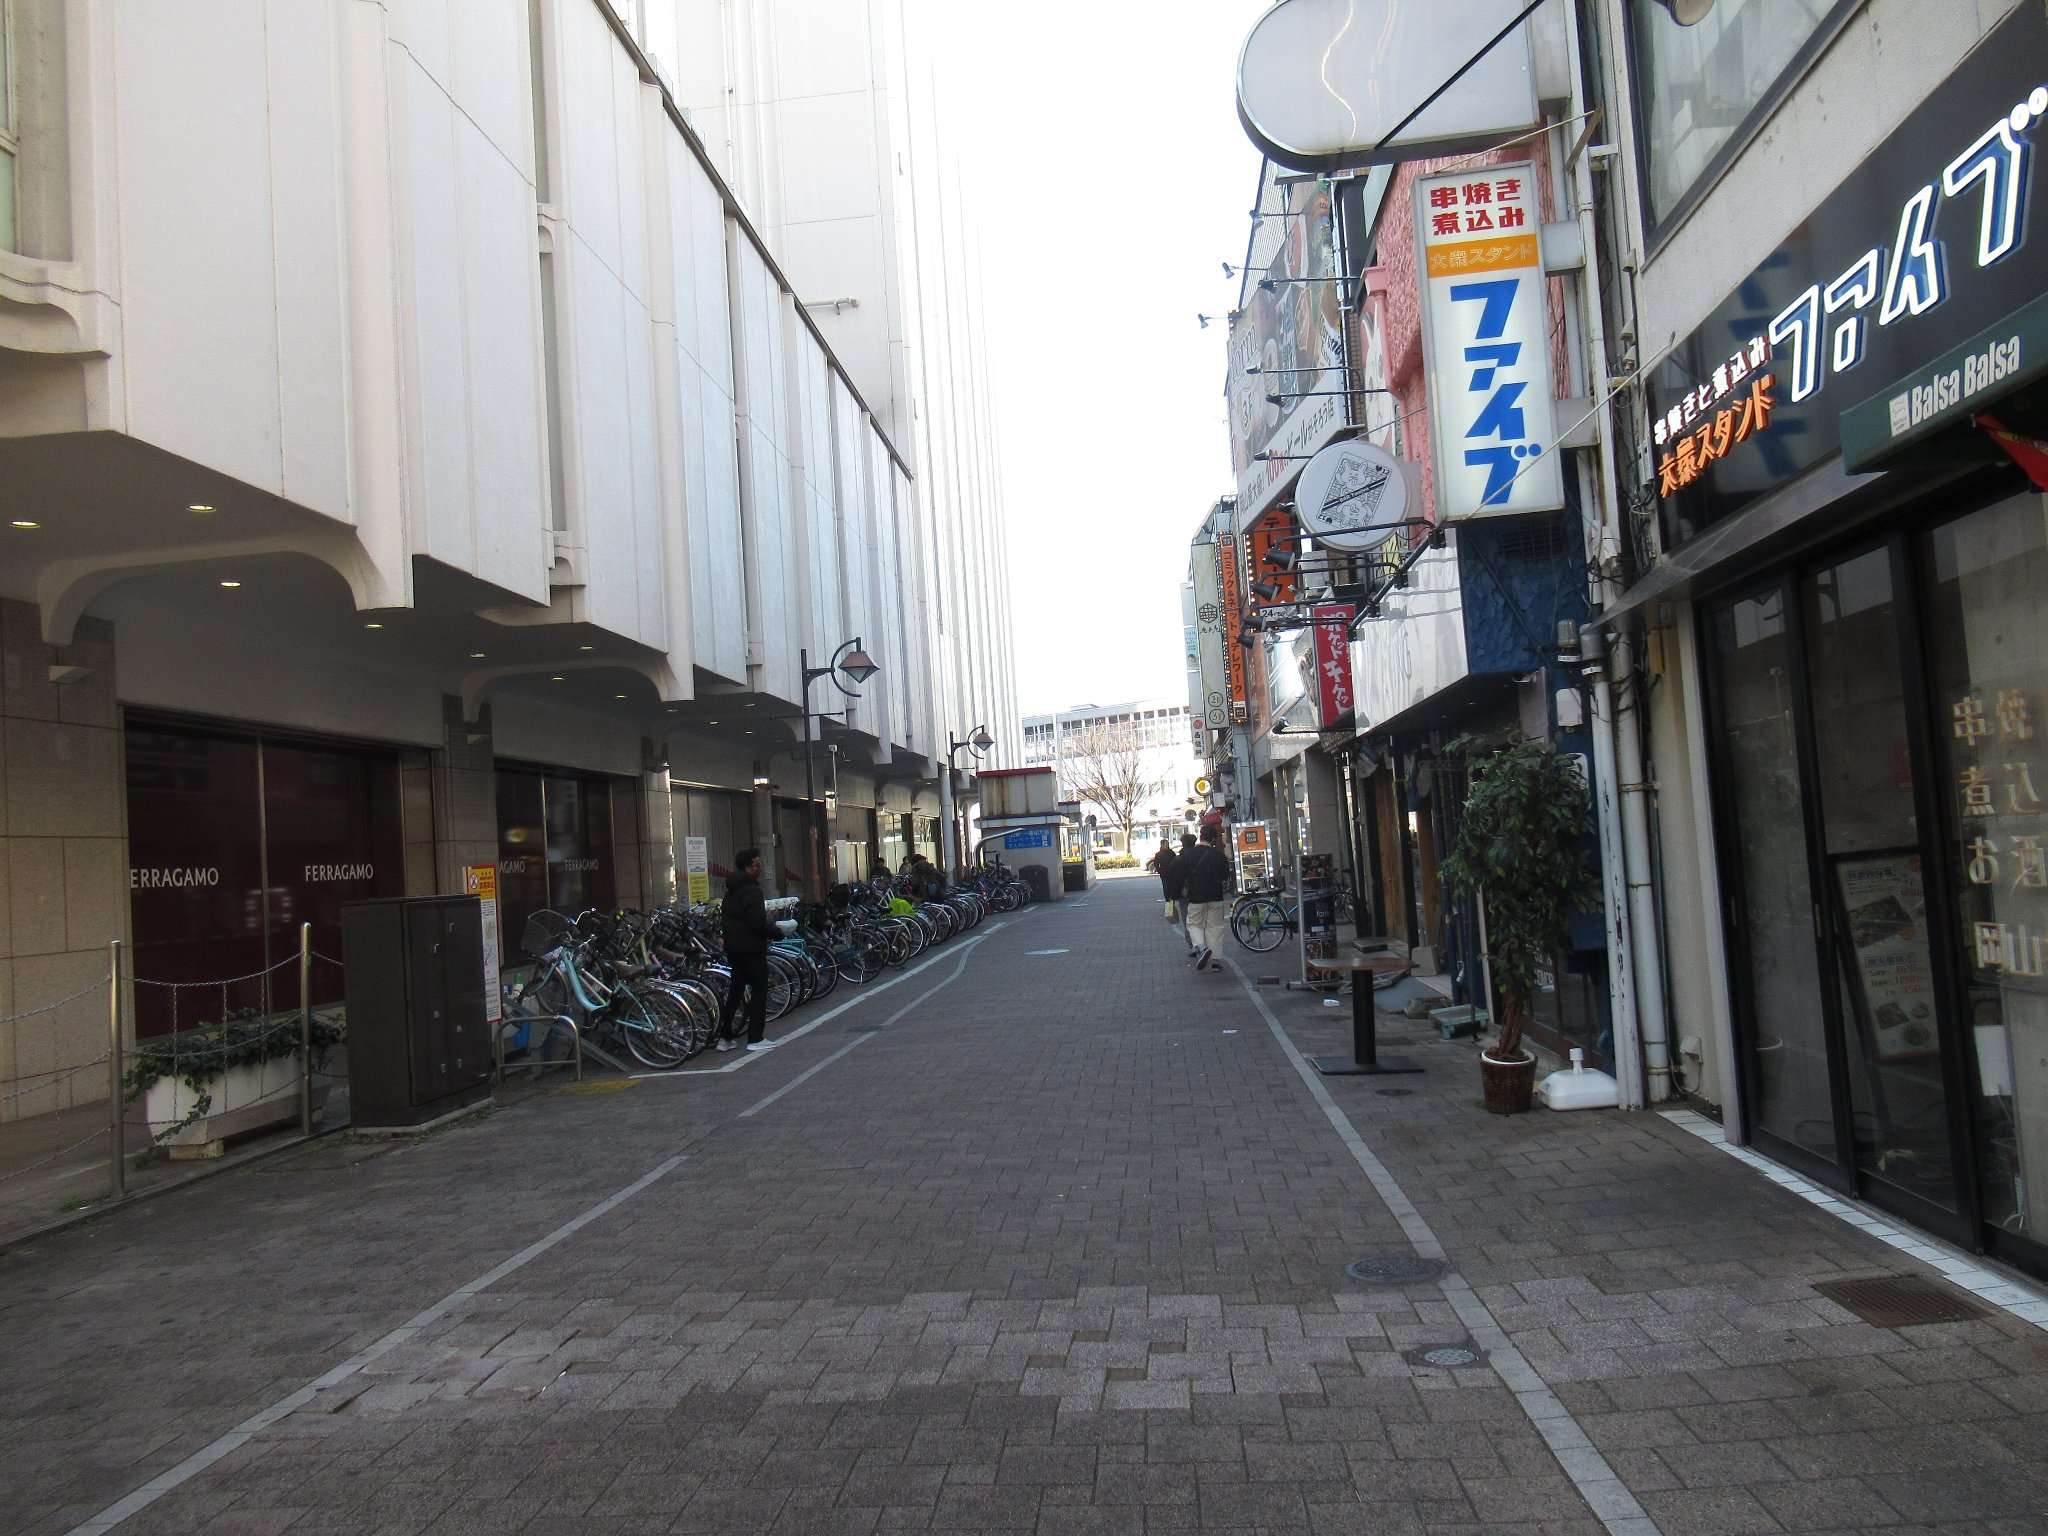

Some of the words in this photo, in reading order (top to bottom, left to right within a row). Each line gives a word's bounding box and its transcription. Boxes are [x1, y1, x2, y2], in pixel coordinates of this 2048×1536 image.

[1430, 180, 1521, 208] 串焼き
[1432, 207, 1524, 235] 煮込み
[1430, 243, 1533, 269] 大衆スタンド
[1768, 86, 2048, 403] ファイブ
[1450, 279, 1542, 505] ファイブ
[1654, 336, 1771, 445] 串焼きと煮込み
[1911, 370, 1960, 426] Balsa
[1964, 335, 2020, 399] Balsa
[1658, 374, 1777, 498] 大衆スタンド
[305, 863, 374, 882] FERRAGAMO
[564, 858, 600, 874] FERRAGAMO
